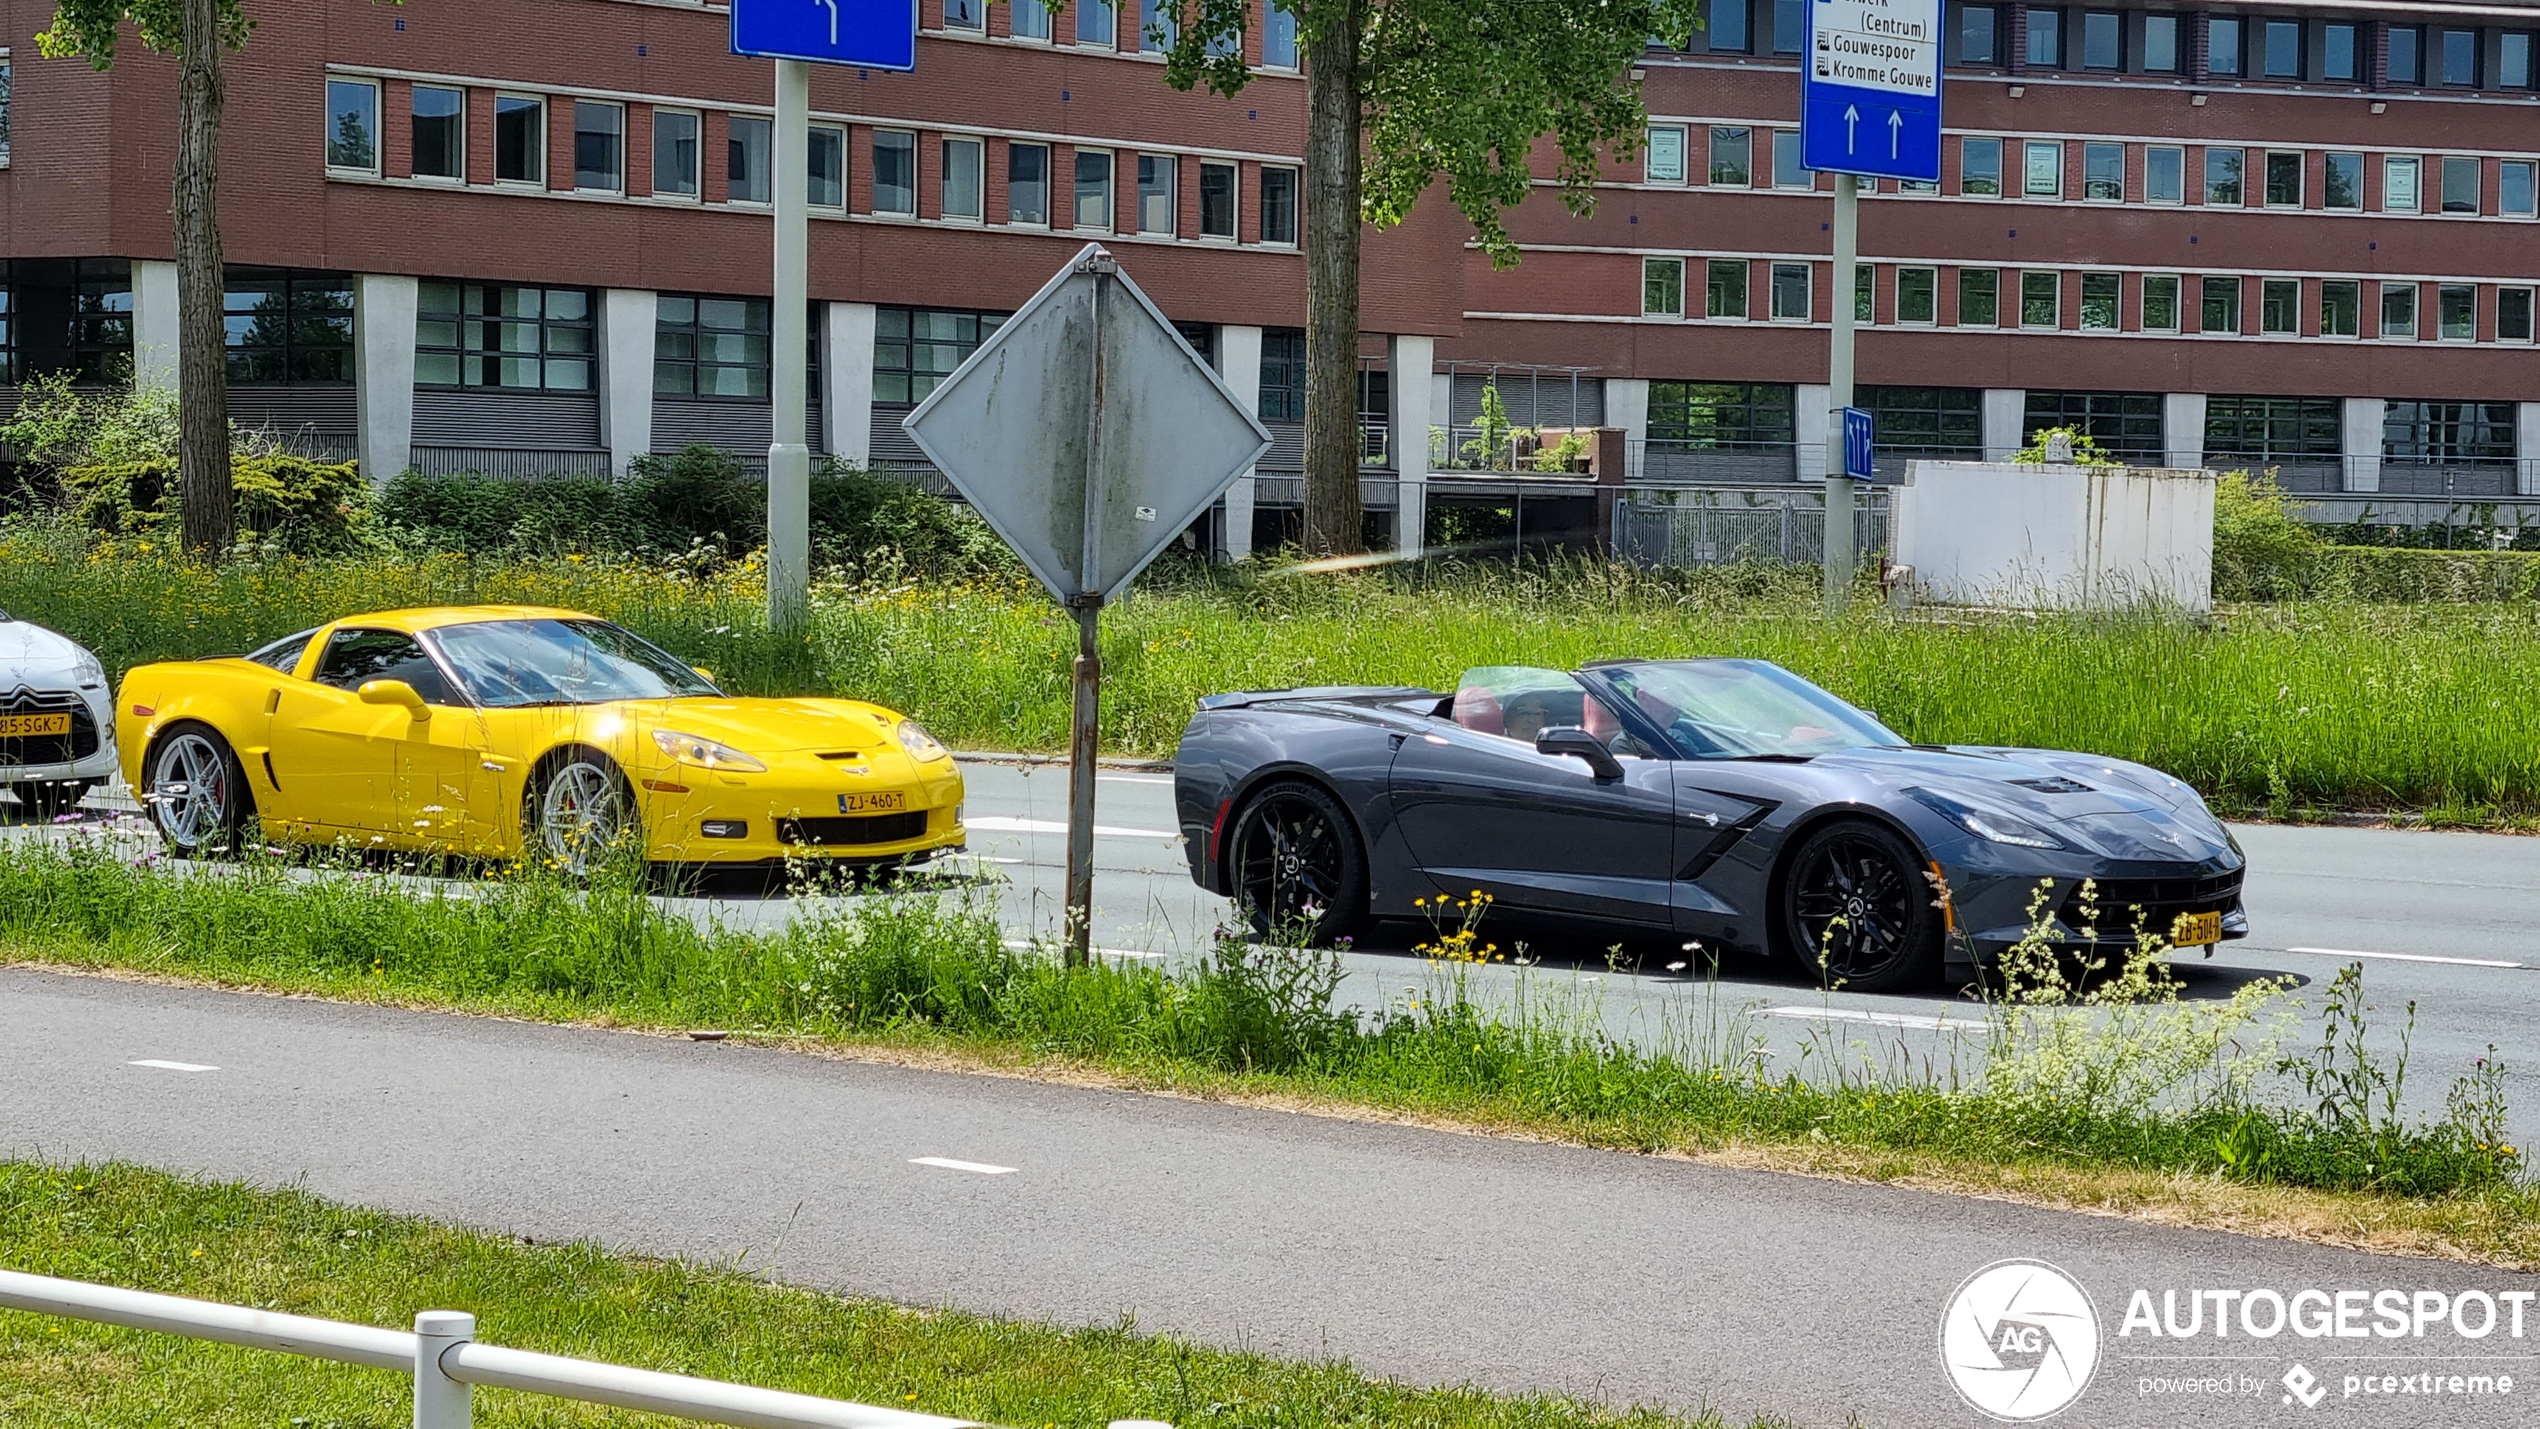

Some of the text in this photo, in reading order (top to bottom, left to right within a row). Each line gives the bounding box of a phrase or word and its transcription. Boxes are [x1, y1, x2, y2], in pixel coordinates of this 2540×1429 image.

[1861, 10, 1927, 40] (Centrum)
[1834, 35, 1916, 62] Gouwespoor
[1833, 60, 1932, 88] Kromme Gouwe
[0, 717, 65, 733] 85-SGK-7
[848, 794, 902, 810] ZJ-460-T
